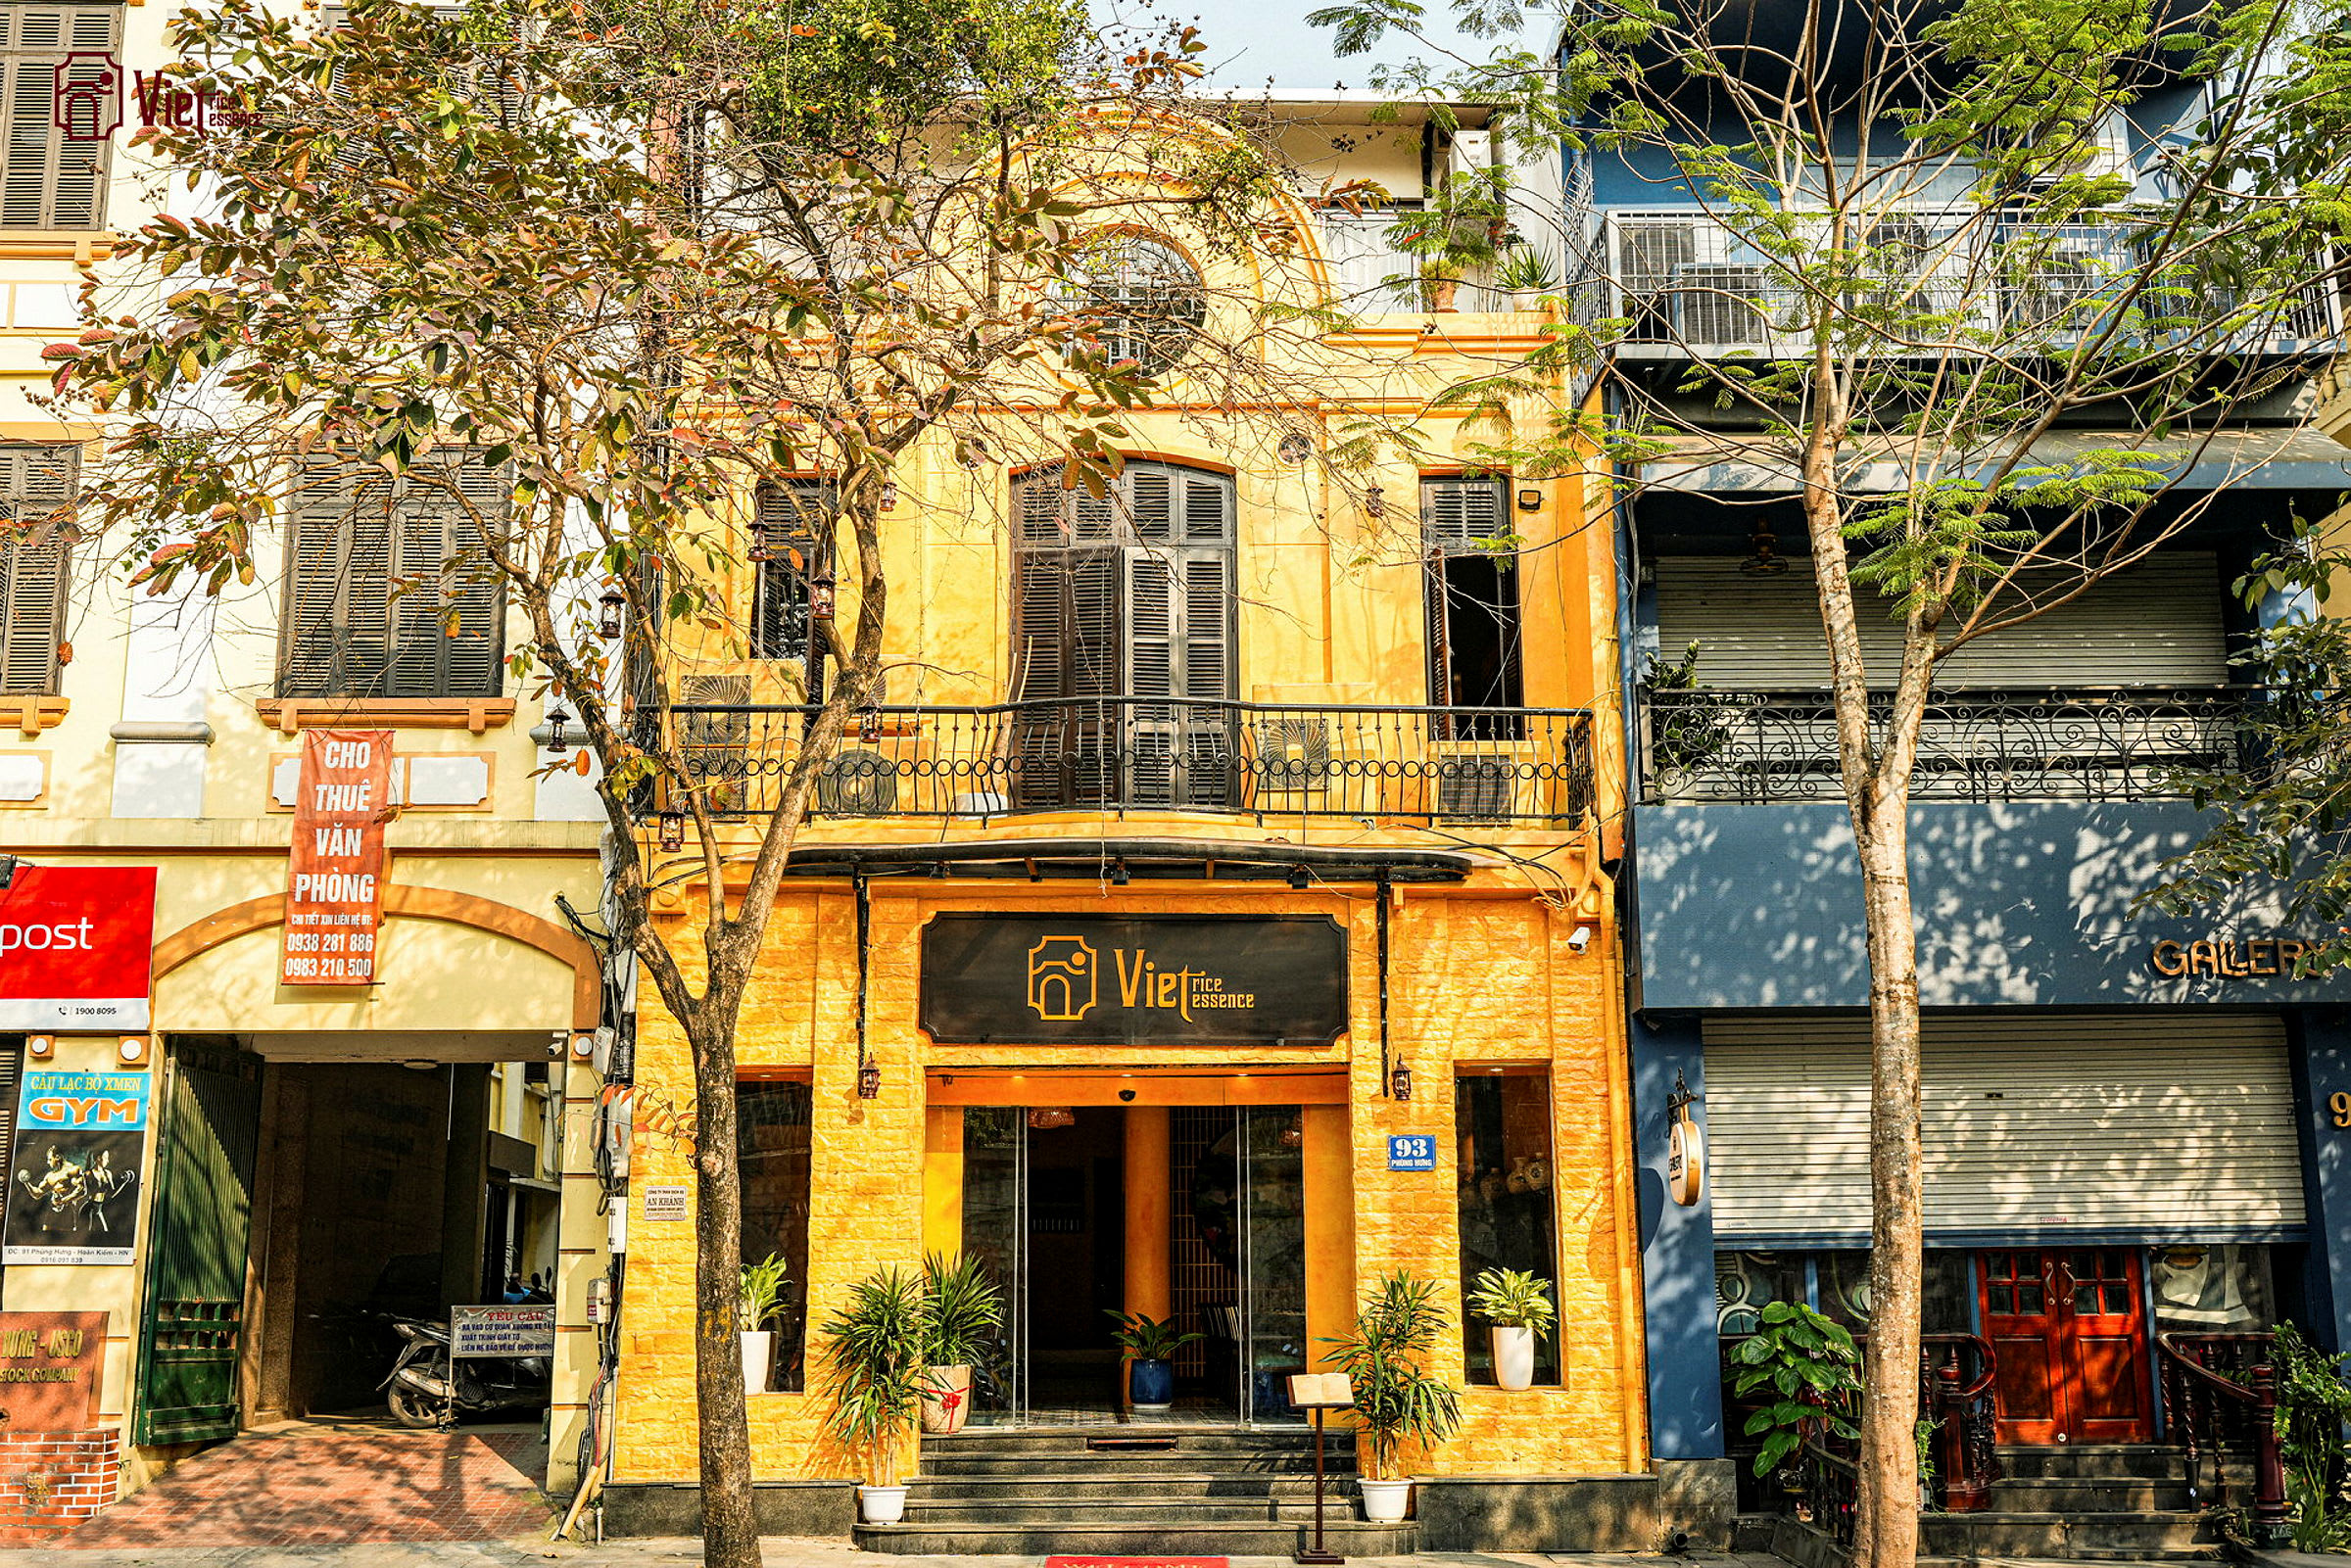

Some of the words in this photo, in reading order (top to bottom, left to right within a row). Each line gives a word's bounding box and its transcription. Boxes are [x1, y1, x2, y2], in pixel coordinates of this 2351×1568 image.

[324, 741, 371, 769] CHO
[315, 779, 372, 812] THUÊ
[315, 823, 362, 857] VĂN
[294, 867, 375, 903] PHÒNG
[321, 914, 334, 926] XIN
[0, 917, 94, 957] post
[287, 932, 319, 952] 0938
[322, 933, 346, 952] 281
[350, 933, 373, 952] 886
[285, 958, 318, 976] 0983
[320, 958, 345, 976] 210
[347, 958, 371, 976] 500
[1113, 948, 1207, 1023] Viet
[1192, 977, 1223, 992] rice
[1192, 993, 1255, 1008] essence
[59, 1075, 83, 1095] LẠC
[104, 1077, 142, 1091] XMEN
[29, 1097, 139, 1125] GYM
[1395, 1138, 1428, 1158] 93
[0, 1368, 31, 1383] STOCK
[31, 1367, 80, 1383] COMPANY
